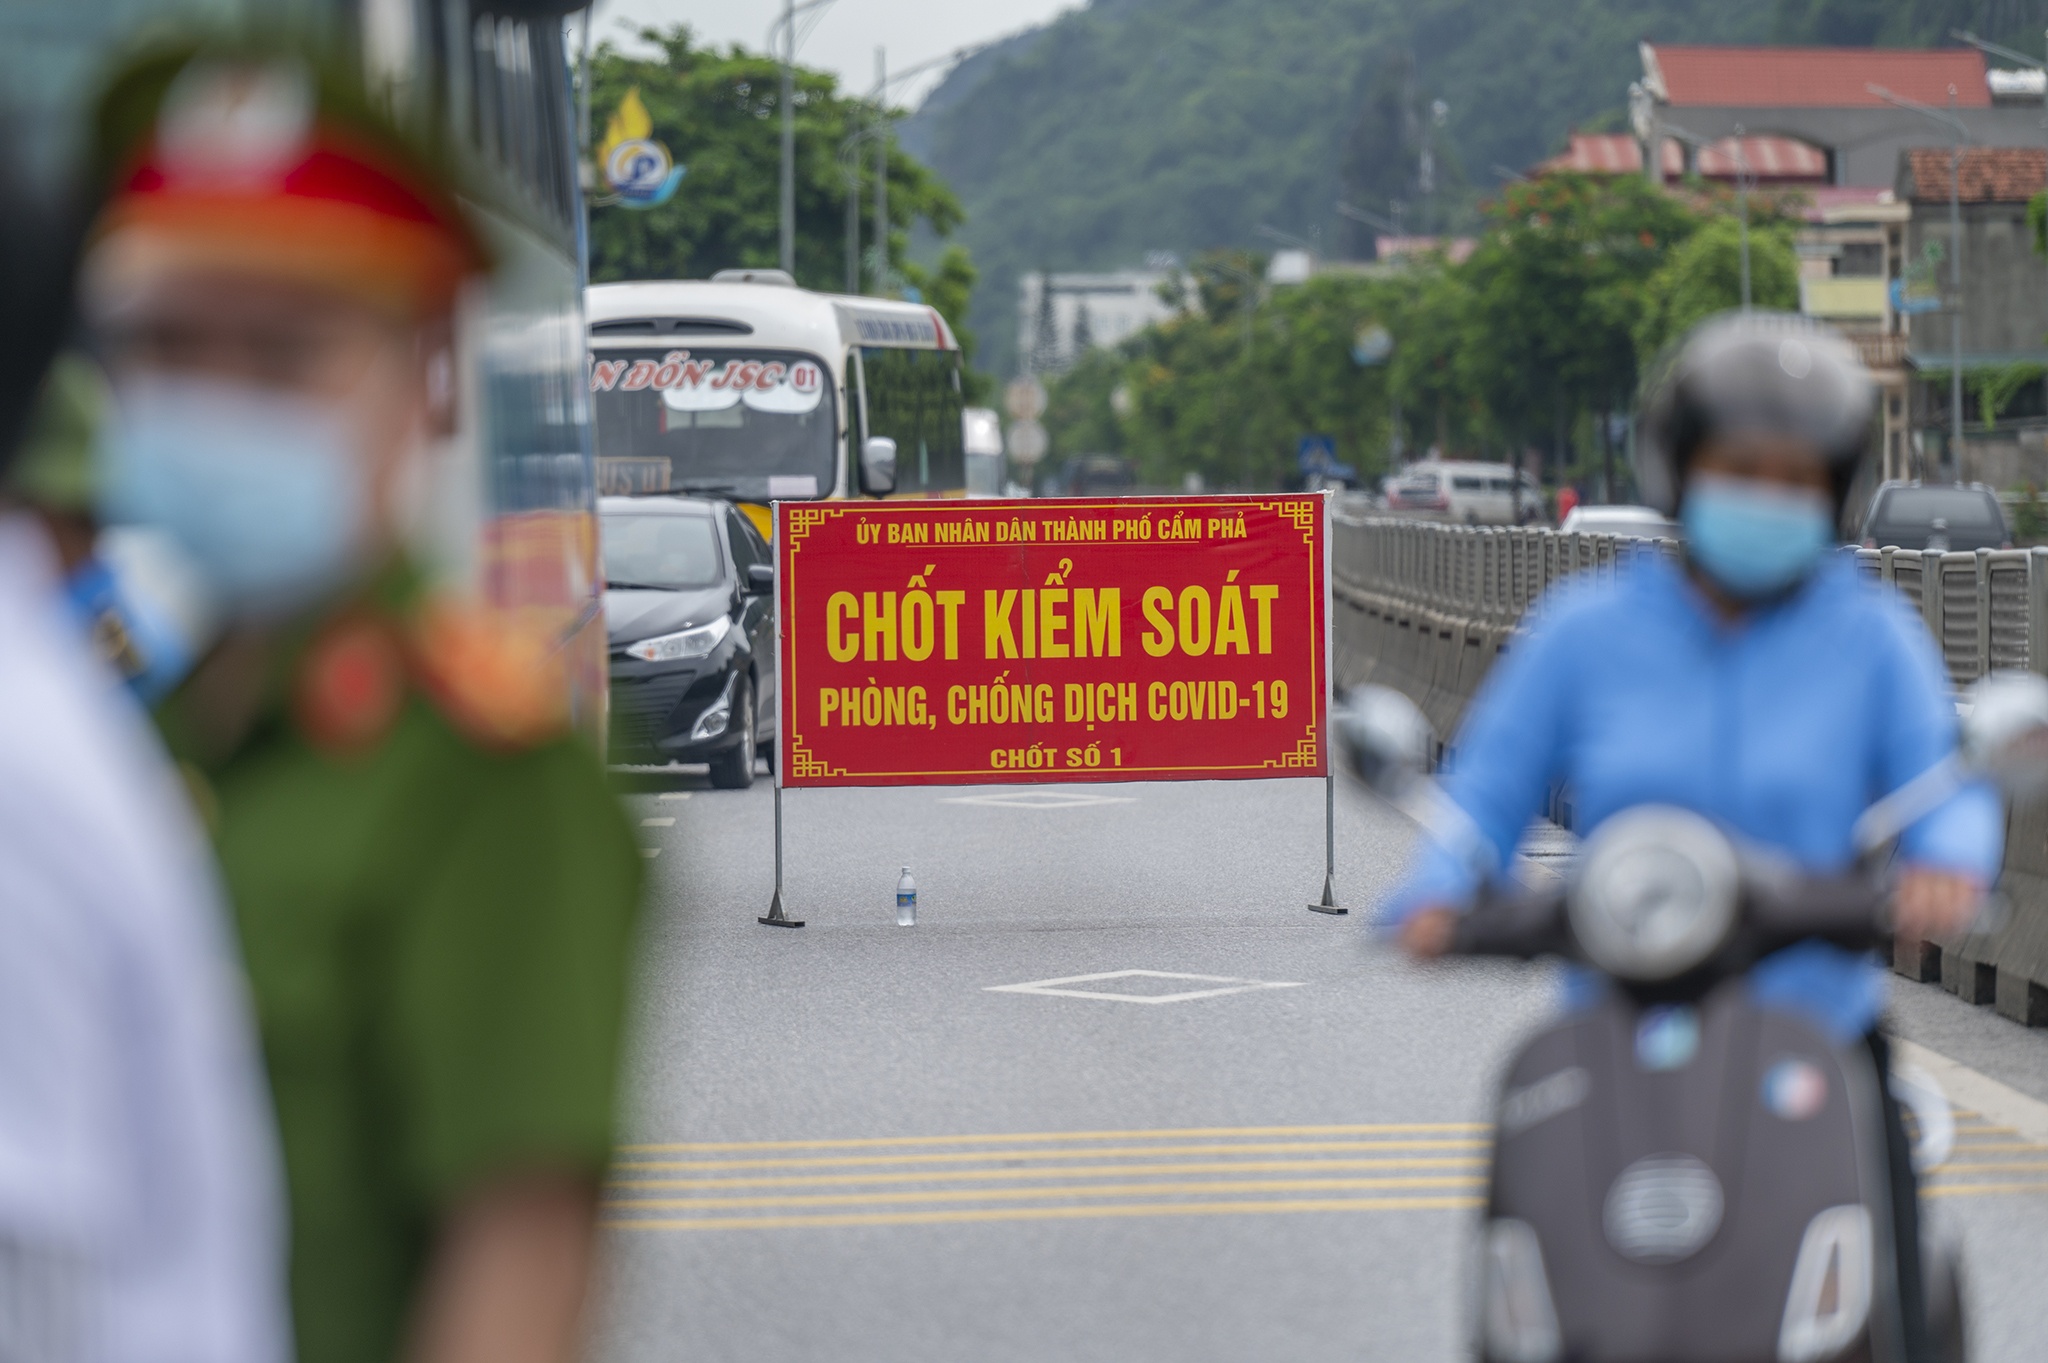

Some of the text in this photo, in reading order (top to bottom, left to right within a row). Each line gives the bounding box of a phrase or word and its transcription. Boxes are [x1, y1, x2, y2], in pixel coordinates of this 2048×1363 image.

[588, 354, 628, 391] N
[710, 359, 787, 391] JSC
[795, 366, 817, 388] 01
[856, 510, 1248, 545] ỦY BAN NHÂN DÂN THÀNH PHỐ CẨM PHẢ
[826, 557, 1279, 663] CHỐT KIỂM SOÁT
[819, 669, 1289, 732] PHÒNG, CHỐNG DỊCH COVID-19
[990, 740, 1121, 769] CHỐT SỐ 1
